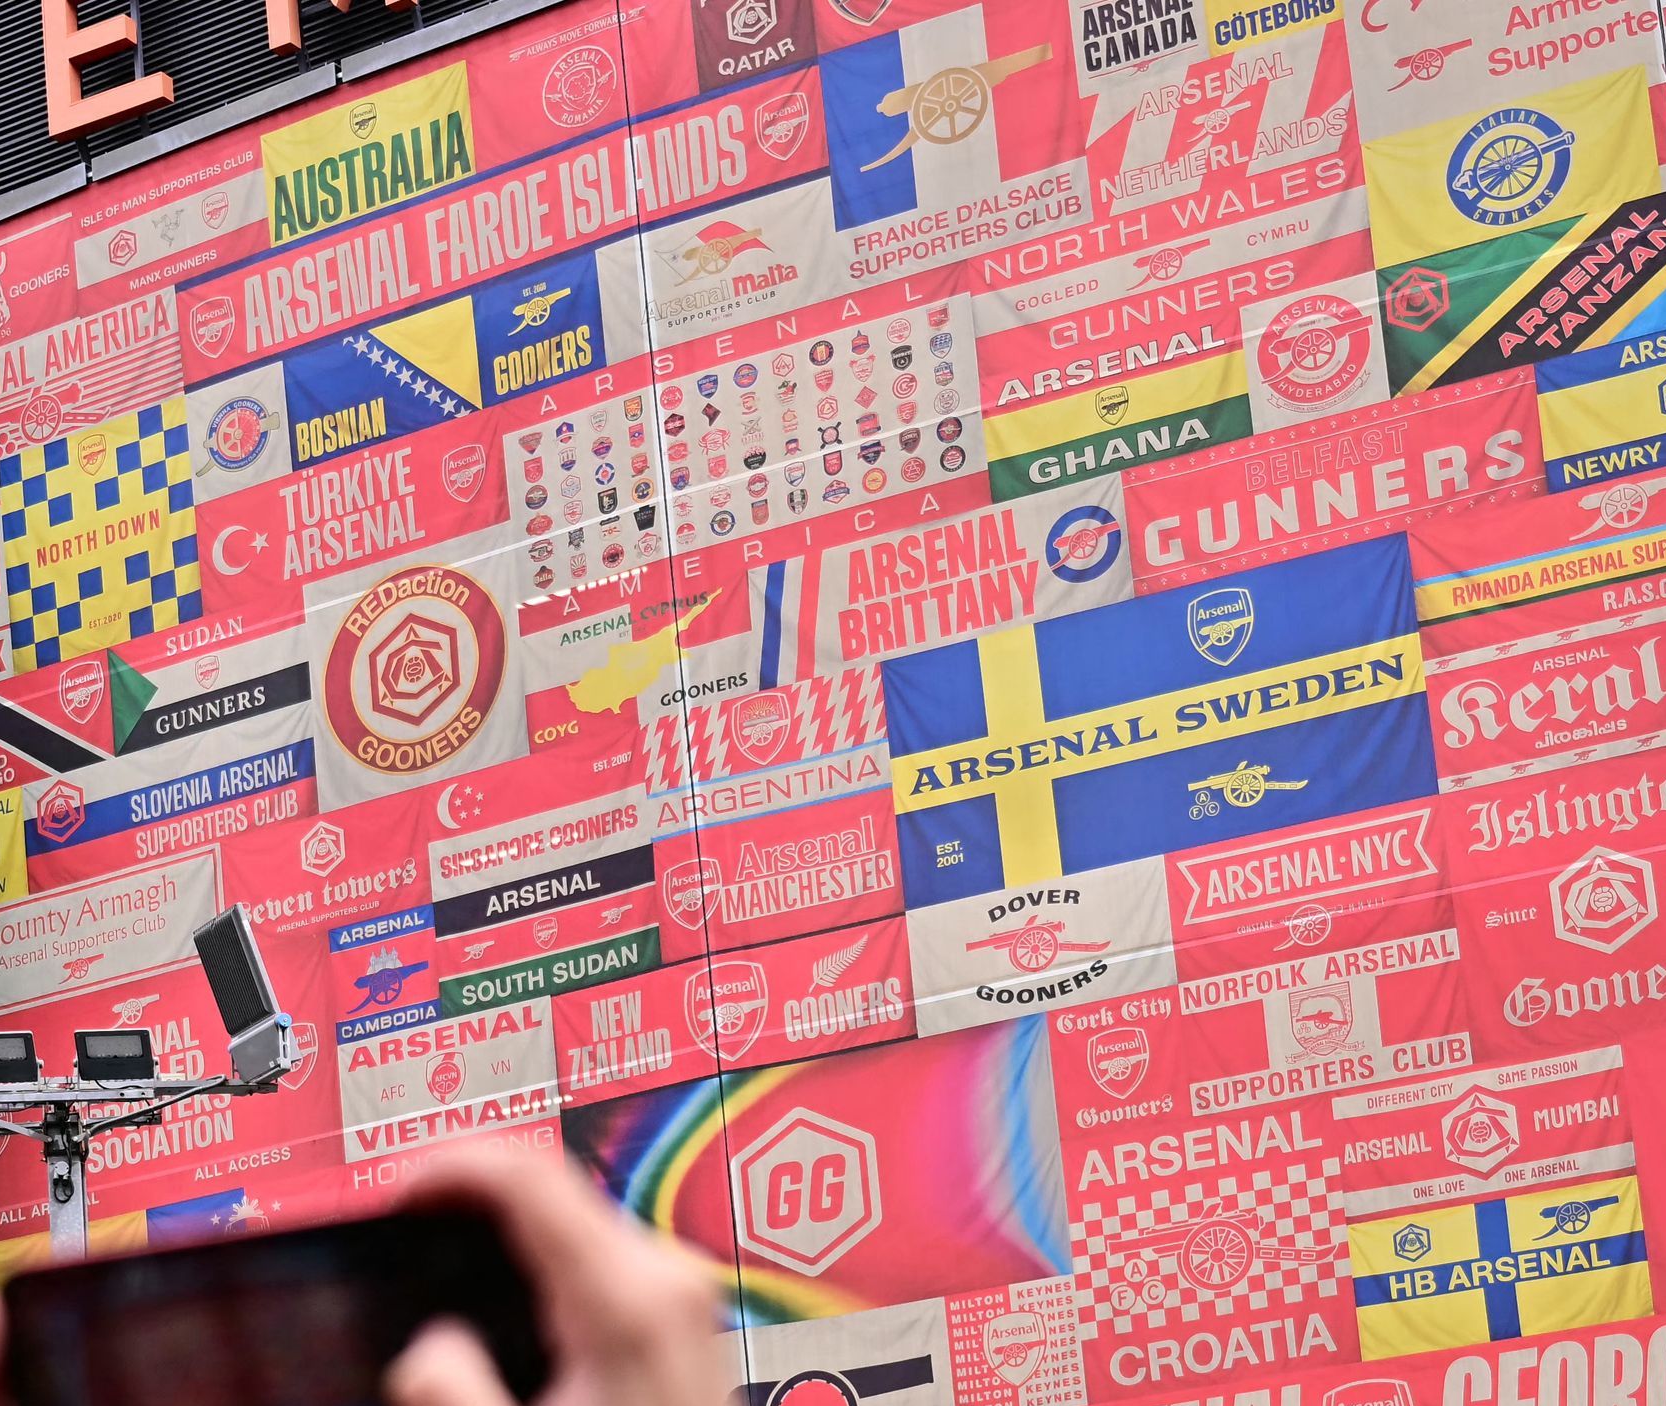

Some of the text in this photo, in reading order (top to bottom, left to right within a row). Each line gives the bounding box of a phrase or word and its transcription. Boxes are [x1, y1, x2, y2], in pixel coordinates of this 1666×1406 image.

[526, 36, 558, 57] ALWAYS
[560, 27, 582, 45] MOVE
[1137, 50, 1293, 121] ARSENAL
[274, 112, 472, 237] AUSTRALIA
[1099, 107, 1348, 202] NETHERLANDS
[81, 151, 254, 228] ISLE OF MAN SUPPORTERS CLUB
[246, 105, 747, 353] ARSENAL FAROE ISLANDS
[850, 196, 1082, 279] SUPPORTERS CLUB
[853, 211, 950, 256] FRANCE
[9, 265, 70, 298] GOONERS
[130, 250, 217, 290] MANX GUNNERS
[1496, 207, 1660, 356] ARSENAL
[45, 294, 170, 387] AMERICA
[279, 447, 416, 530] TÜRKİYE
[1244, 421, 1409, 493] BELFAST
[1144, 430, 1524, 567] GUNNERS
[37, 509, 162, 568] NORTH DOWN
[284, 506, 425, 580] ARSENAL
[848, 508, 1028, 605] ARSENAL
[346, 568, 470, 637] REDaction
[838, 560, 1038, 661] BRITTANY
[1452, 572, 1534, 606] RWANDA
[1540, 550, 1628, 588] ARSENAL
[165, 617, 244, 656] SUDAN
[1533, 647, 1610, 674] ARSENAL
[155, 686, 266, 736] GUNNERS
[358, 705, 483, 773] GOONERS
[908, 653, 1404, 795] ARSENAL SWEDEN
[131, 750, 297, 822] SLOVENIA ARSENAL
[136, 789, 299, 858] SUPPORTERS CLUB
[937, 842, 962, 856] EST.
[486, 871, 601, 917] ARSENAL
[937, 852, 964, 868] 2001
[76, 875, 178, 927] Armagh
[987, 889, 1081, 922] DOVER
[52, 925, 128, 959] Supporters
[132, 914, 167, 938] Club
[462, 944, 639, 1006] SOUTH SUDAN
[976, 959, 1108, 1004] GOONERS
[1182, 931, 1457, 1013] NORFOLK ARSENAL
[568, 978, 904, 1091] ZEALAND GOONERS
[591, 990, 642, 1043] NEW
[1195, 1039, 1468, 1112] SUPPORTERS CLUB
[1344, 1132, 1431, 1165] ARSENAL
[1533, 1096, 1620, 1132] MUMBAI
[1078, 1112, 1323, 1191] ARSENAL
[1389, 1243, 1610, 1300] HB ARSENAL
[1109, 1313, 1337, 1387] CROATIA
